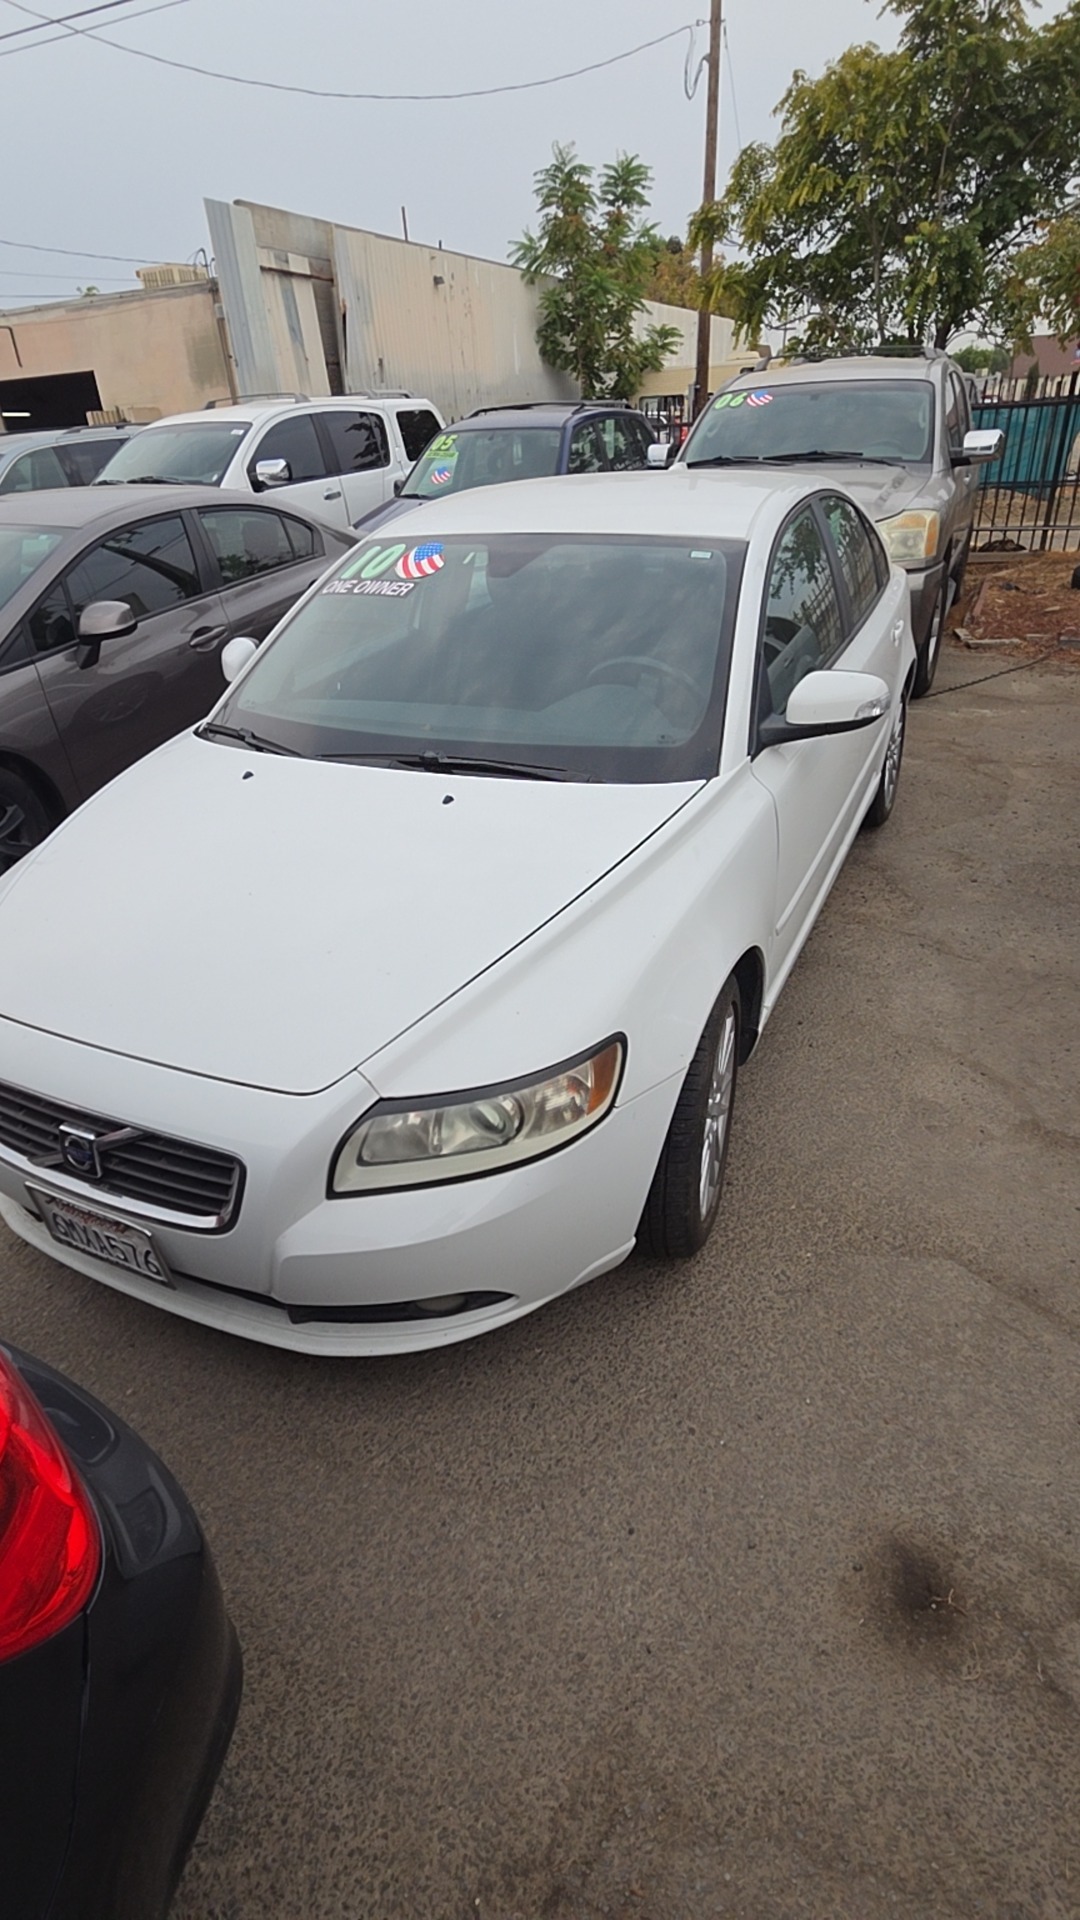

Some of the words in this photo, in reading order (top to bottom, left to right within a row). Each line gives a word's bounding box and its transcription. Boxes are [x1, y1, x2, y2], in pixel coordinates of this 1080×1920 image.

[714, 392, 748, 410] 06
[431, 434, 458, 450] 05
[340, 543, 407, 579] 10
[321, 580, 359, 595] ONE
[353, 580, 415, 597] OWNER
[52, 1212, 162, 1277] 6MXA576
